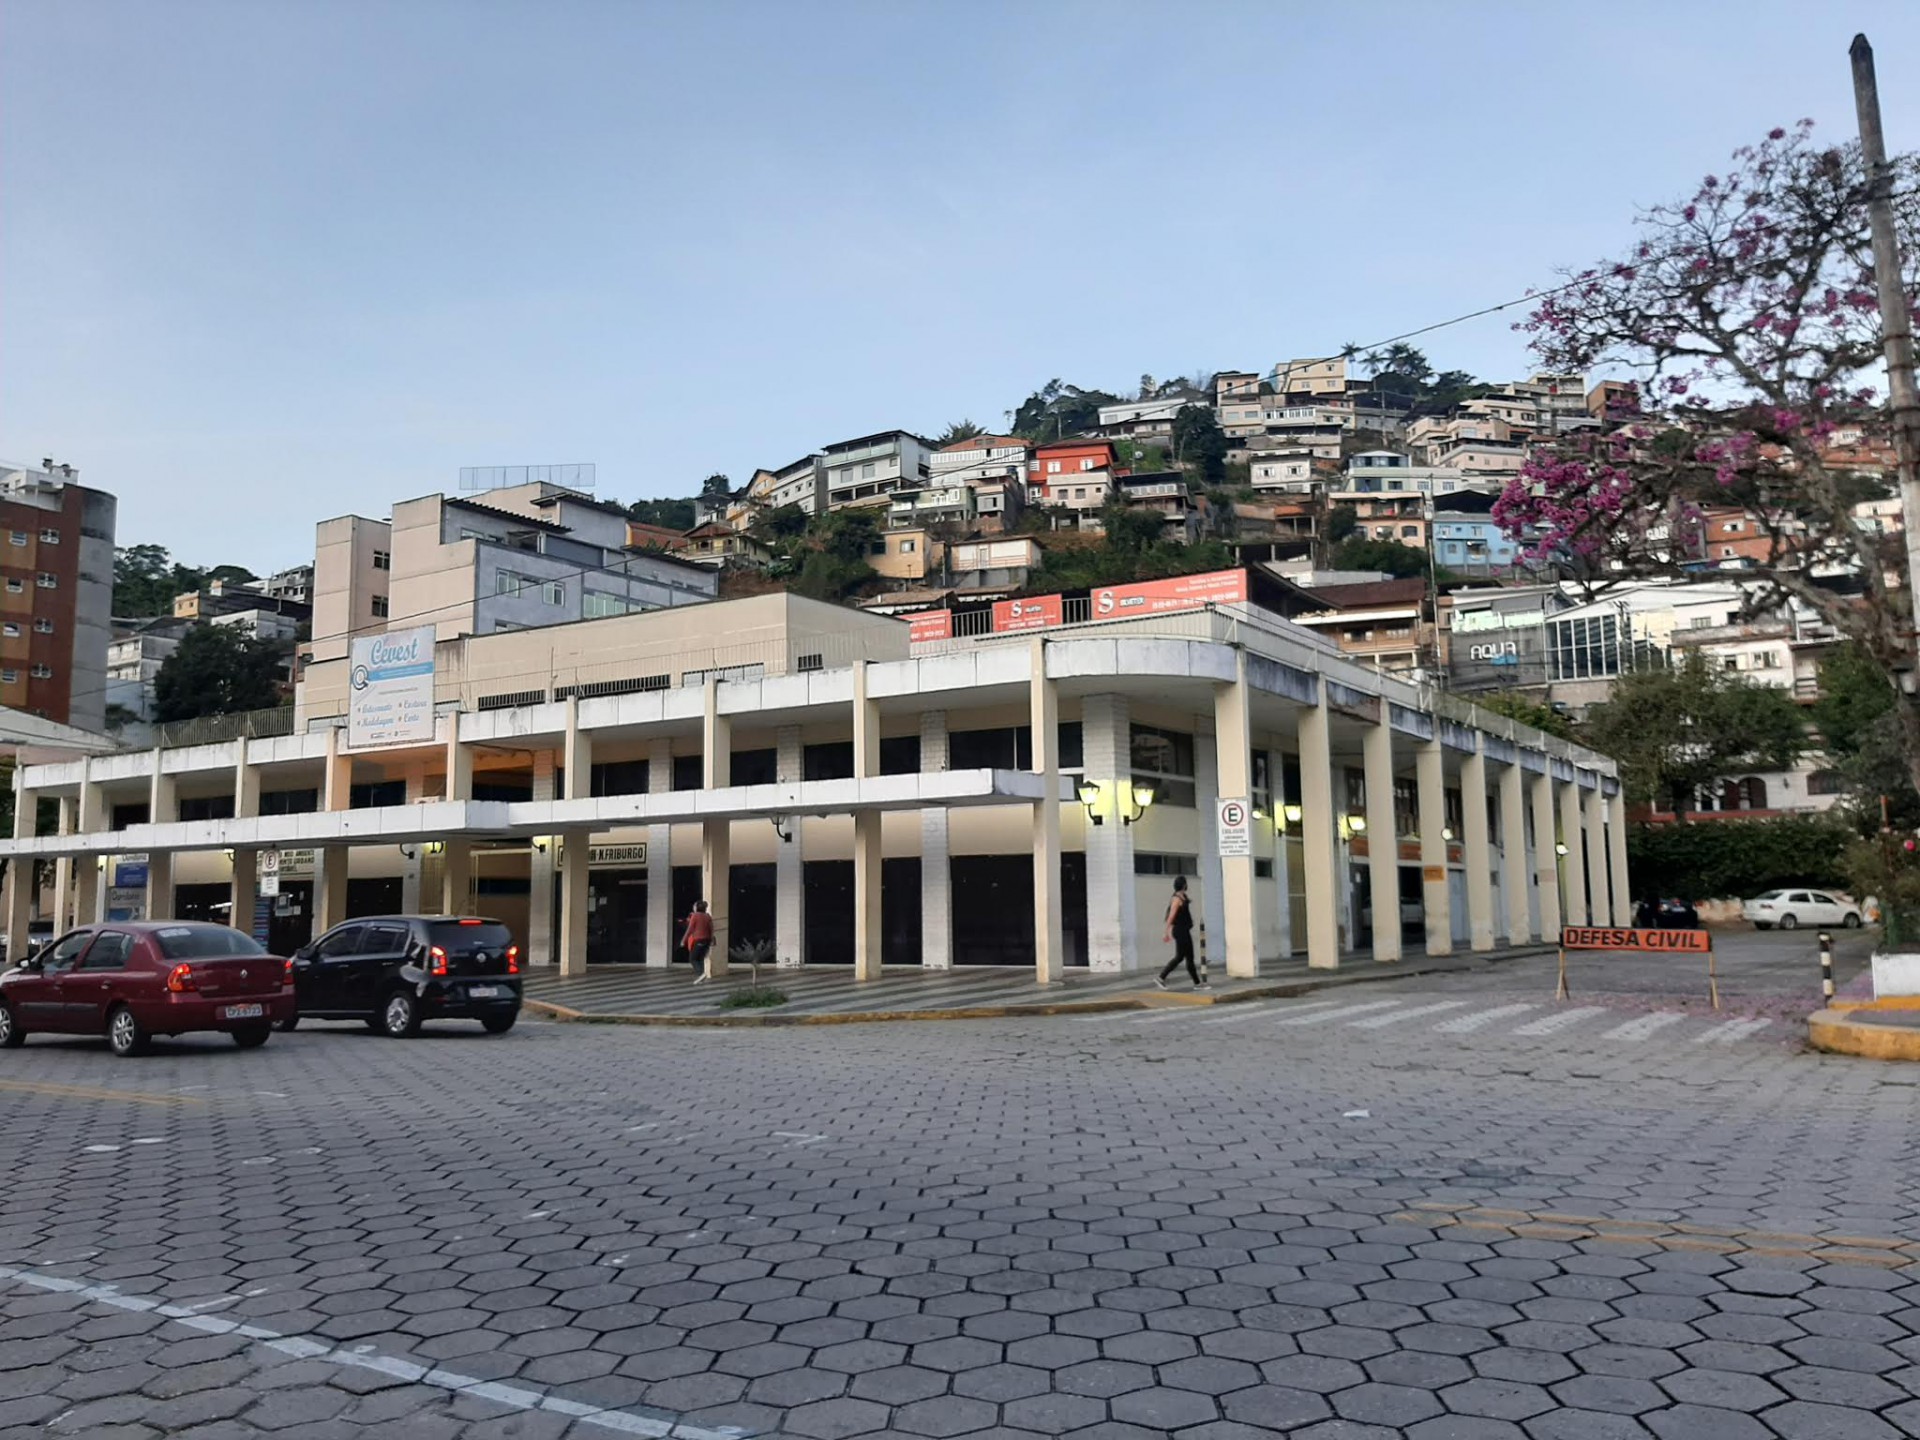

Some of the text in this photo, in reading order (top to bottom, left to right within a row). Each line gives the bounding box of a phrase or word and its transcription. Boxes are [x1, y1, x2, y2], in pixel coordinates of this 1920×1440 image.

[371, 638, 418, 665] Cevest
[1470, 641, 1516, 661] AQUA
[1228, 807, 1238, 822] E
[1566, 929, 1701, 948] DEFESA CIVIL
